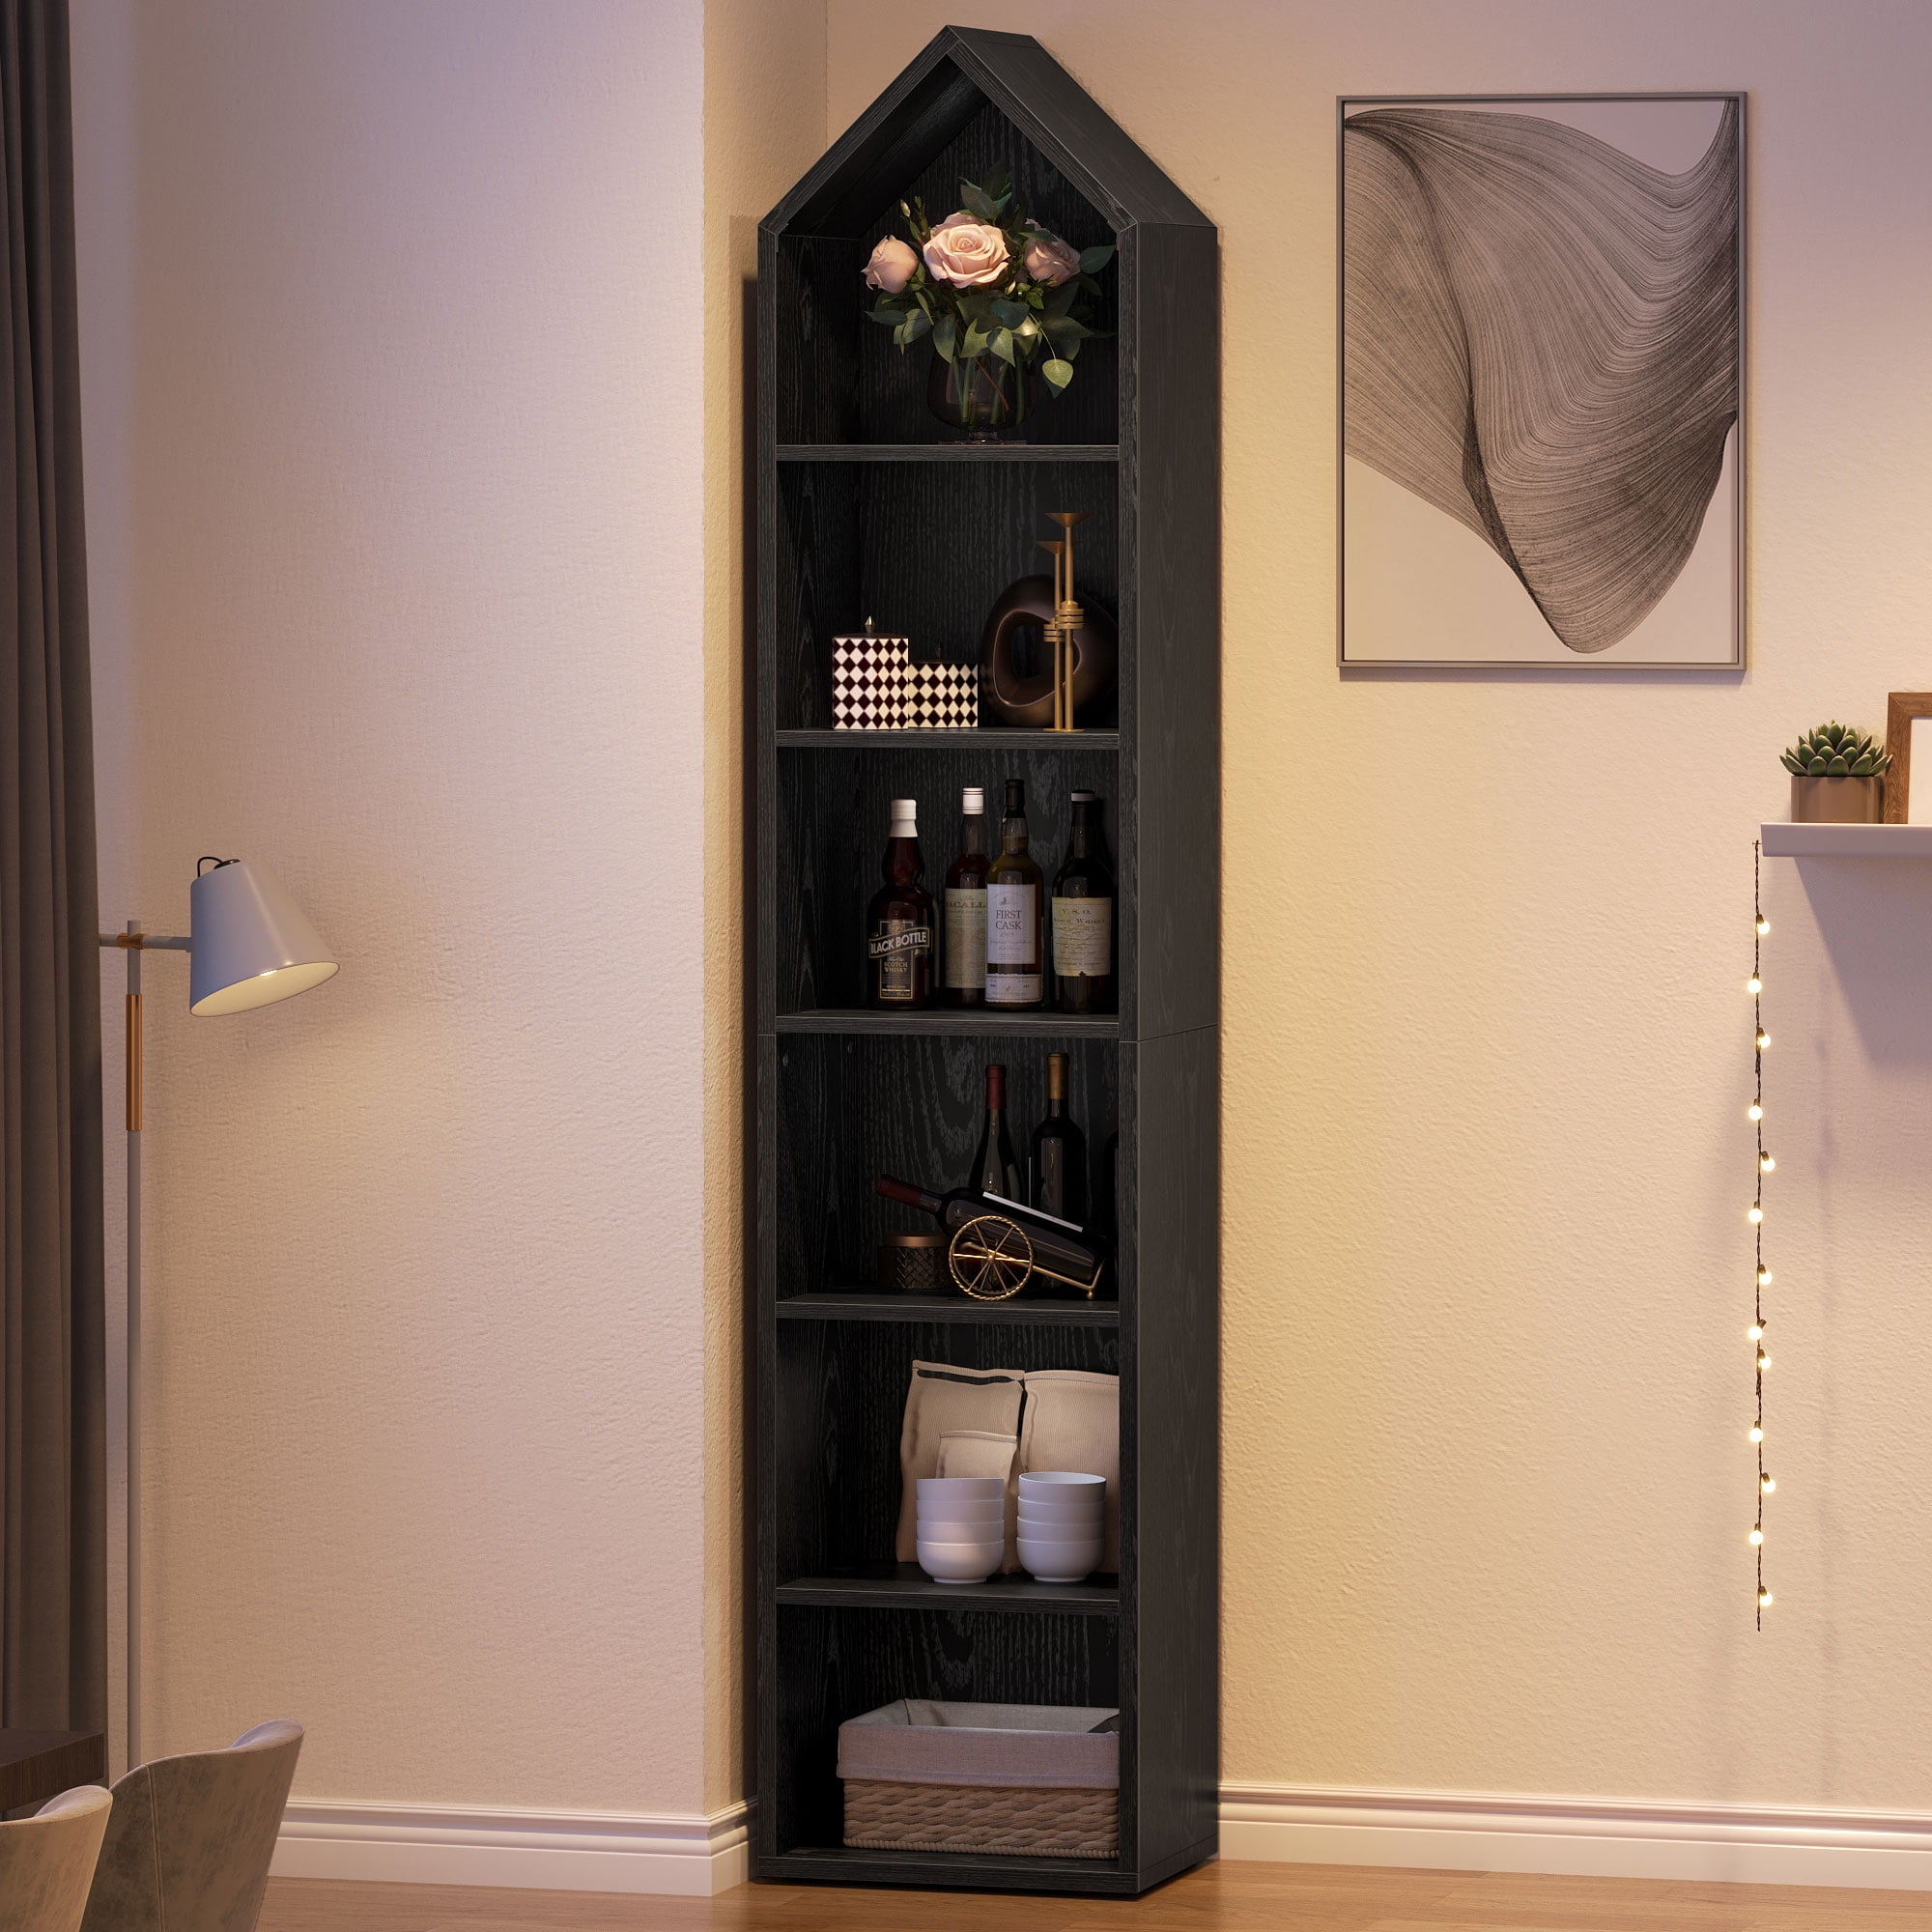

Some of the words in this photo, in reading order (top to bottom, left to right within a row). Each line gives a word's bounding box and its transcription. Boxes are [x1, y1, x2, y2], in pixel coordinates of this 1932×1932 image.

[996, 910, 1022, 919] FIRST
[995, 921, 1022, 930] CASK
[870, 939, 895, 954] BLACK
[895, 932, 926, 948] BOTTLE
